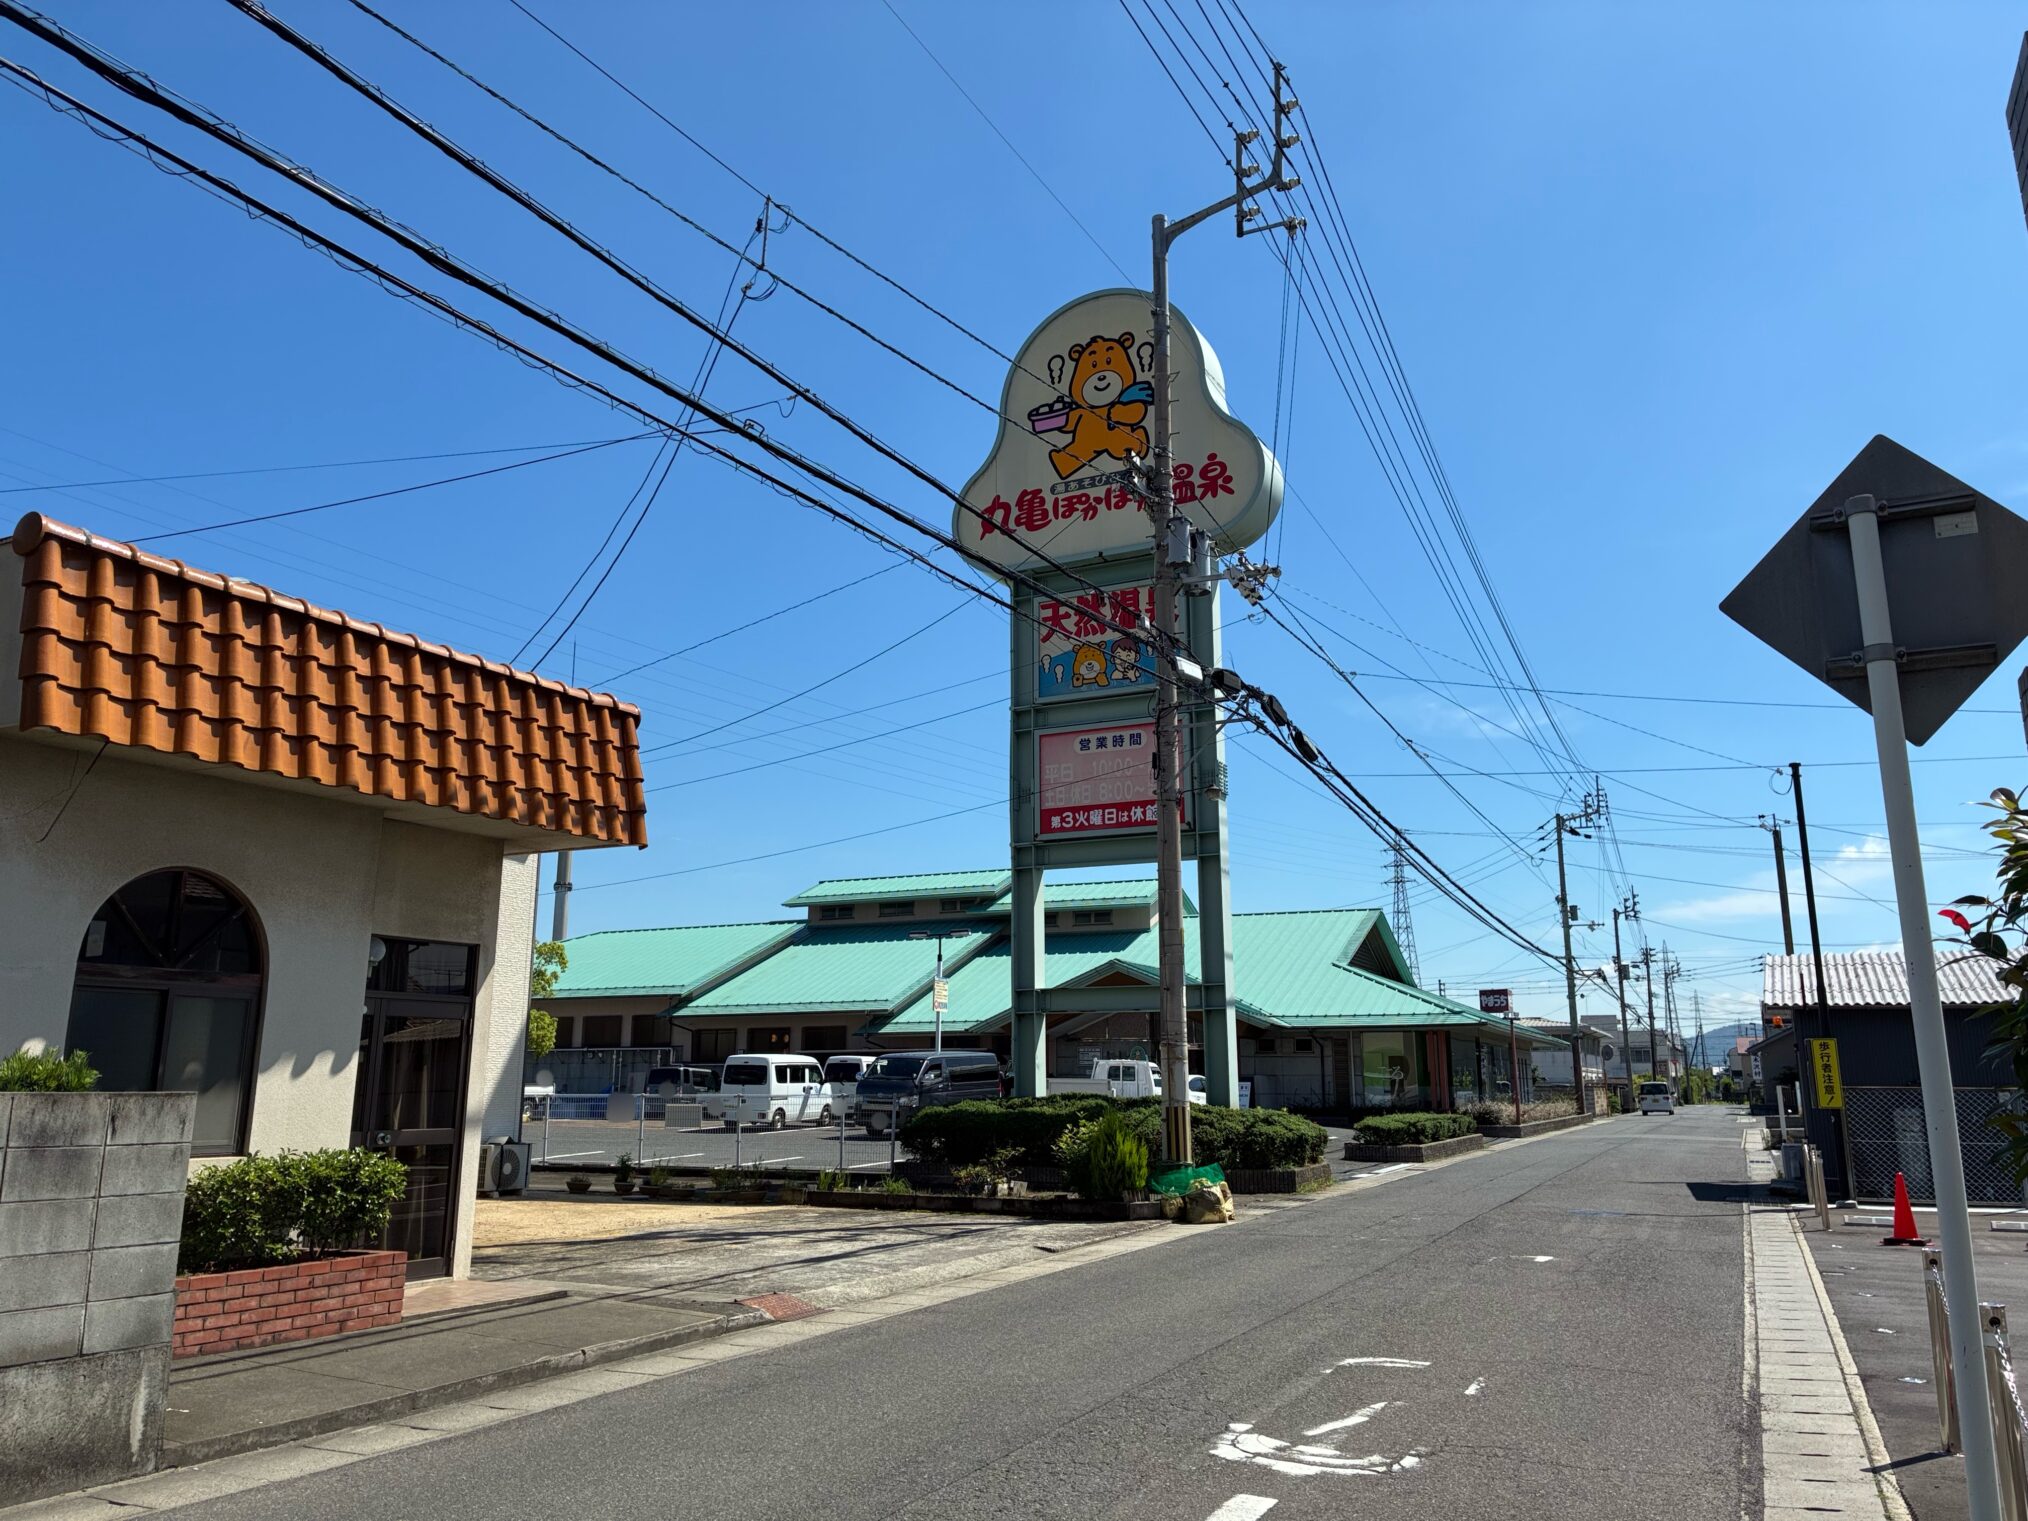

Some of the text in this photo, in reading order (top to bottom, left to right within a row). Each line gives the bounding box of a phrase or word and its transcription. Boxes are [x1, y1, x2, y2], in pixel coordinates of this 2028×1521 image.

[1078, 732, 1142, 751] 営業時間
[1045, 763, 1074, 783] 平日
[1480, 994, 1508, 1009] やまうち
